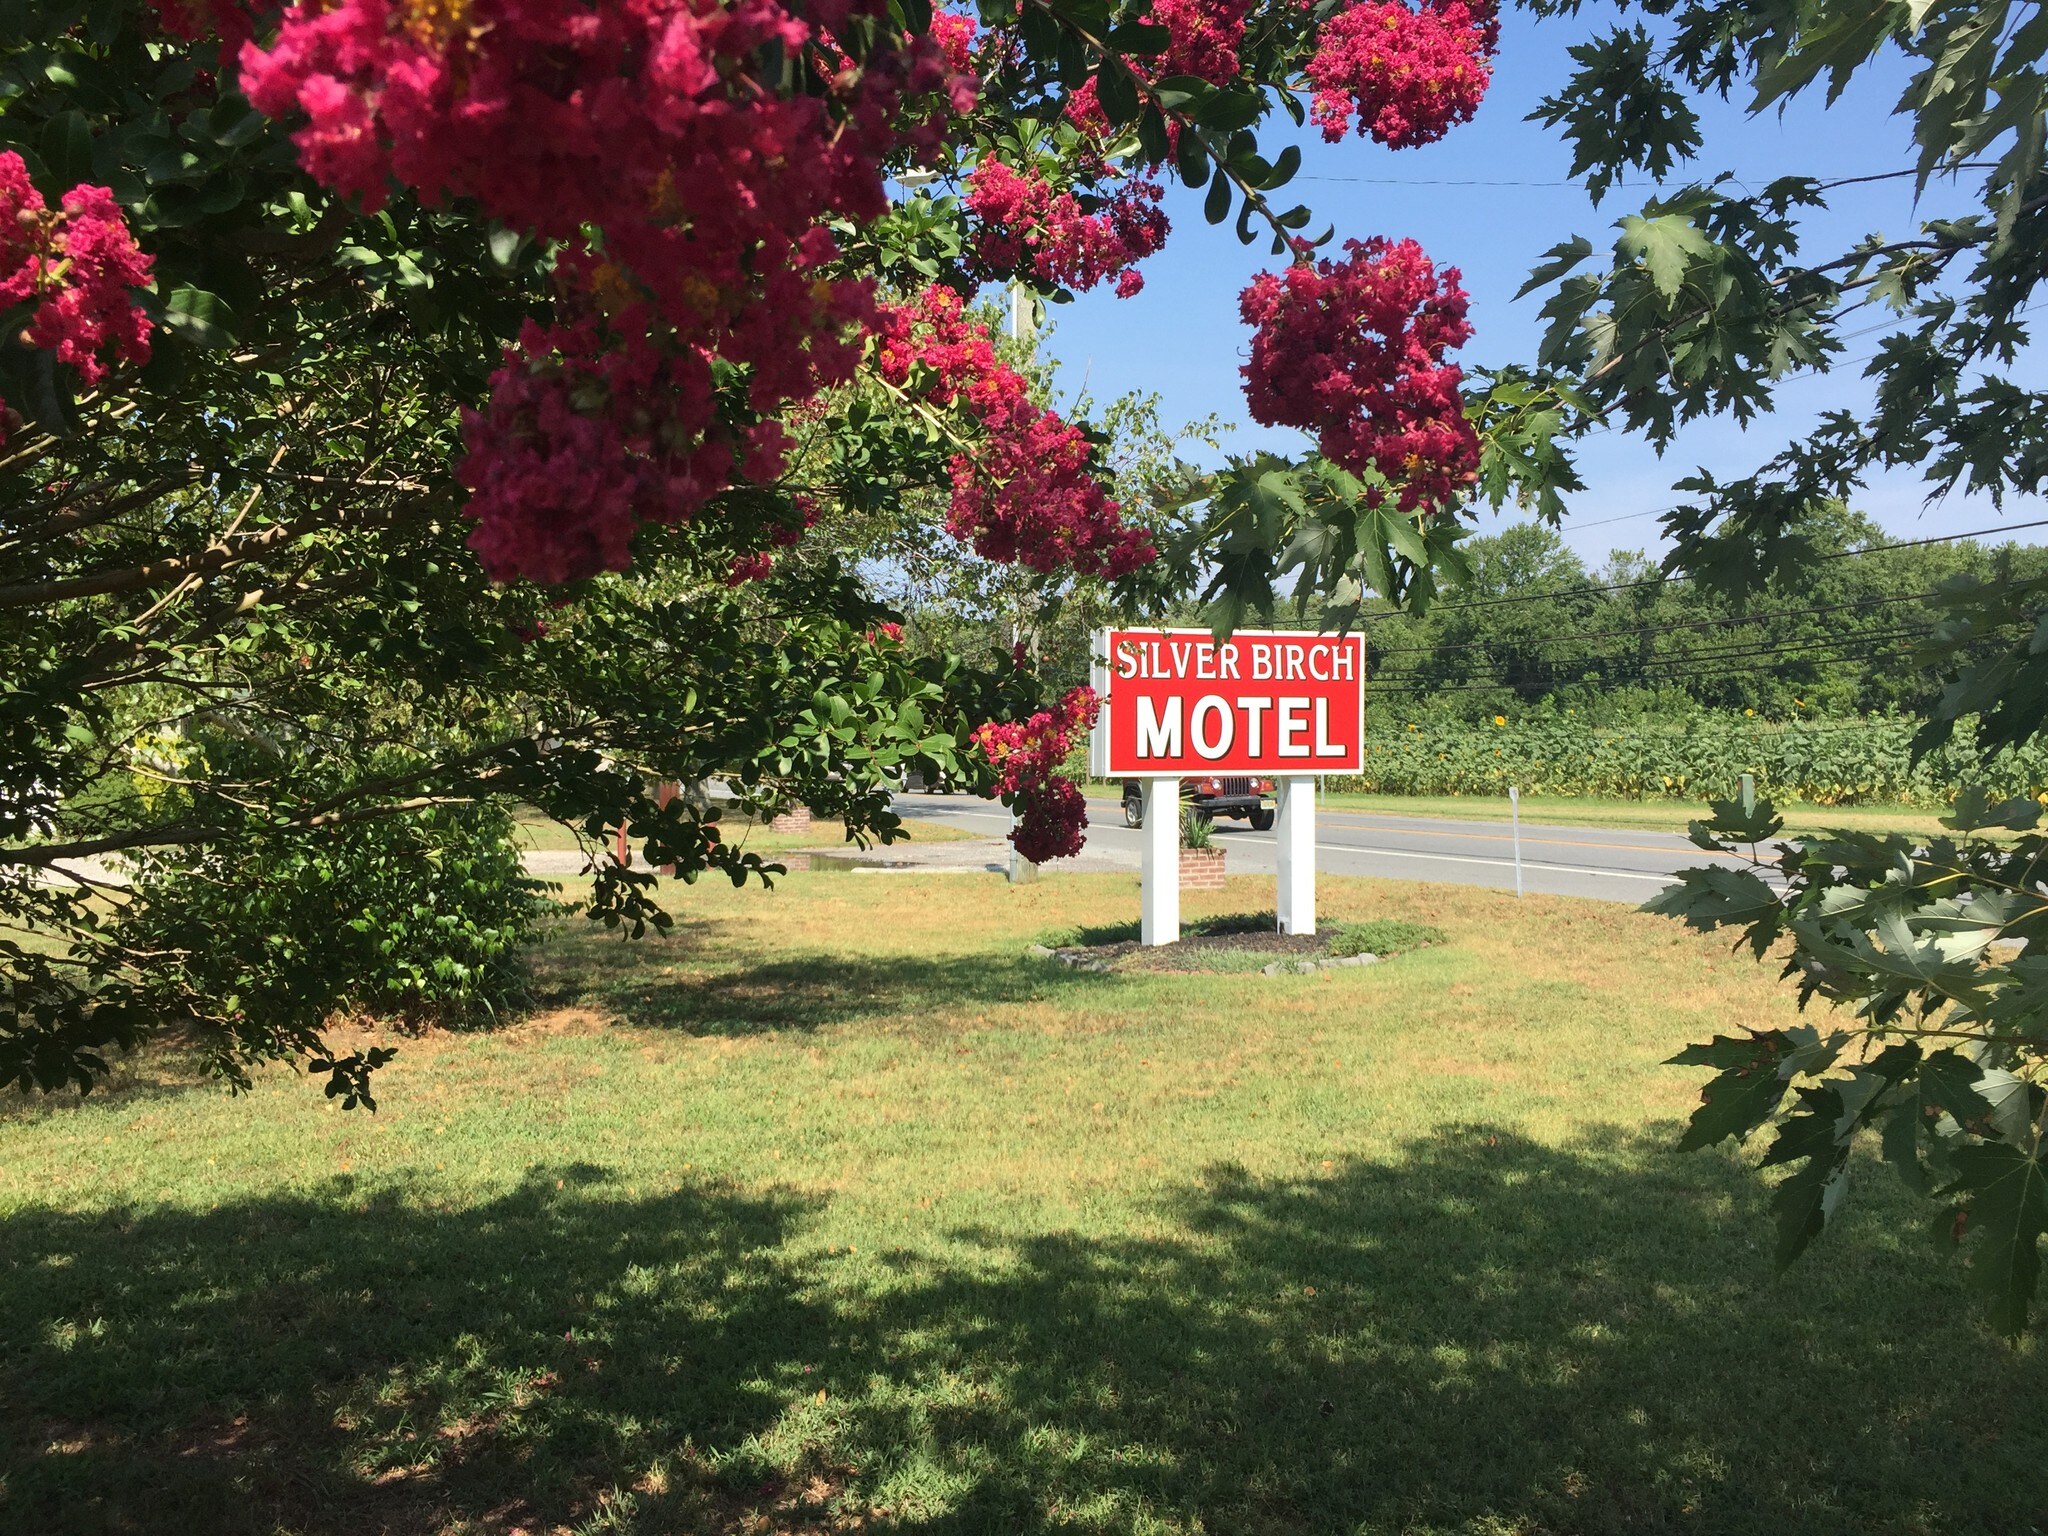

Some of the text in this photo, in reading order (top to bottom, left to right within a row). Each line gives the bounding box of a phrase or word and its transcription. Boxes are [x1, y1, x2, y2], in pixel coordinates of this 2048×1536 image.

[1116, 641, 1354, 681] SILVER BIRCH
[1136, 694, 1347, 759] MOTEL
